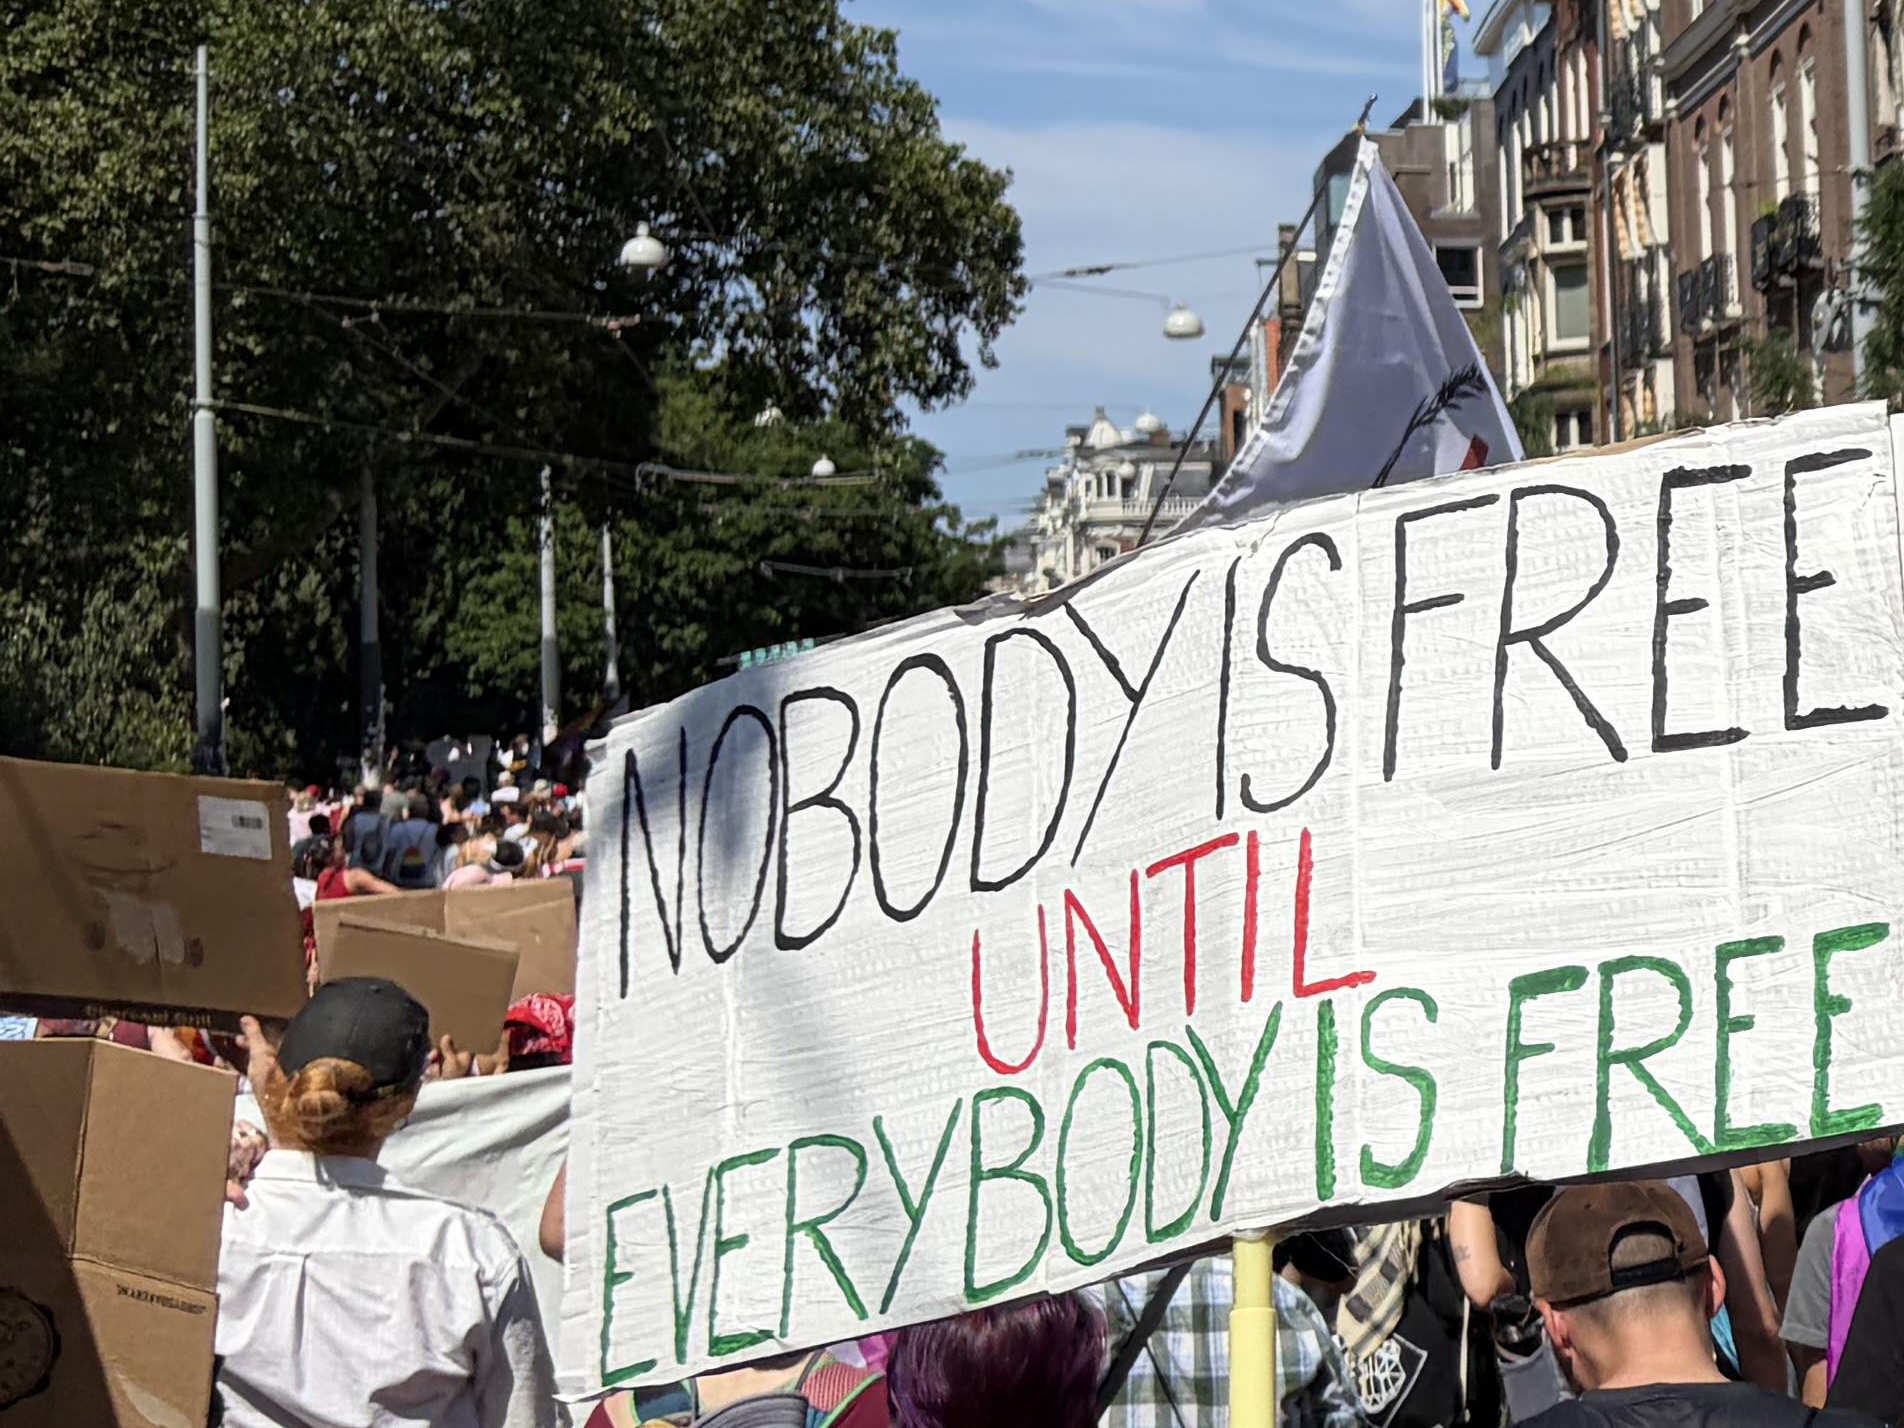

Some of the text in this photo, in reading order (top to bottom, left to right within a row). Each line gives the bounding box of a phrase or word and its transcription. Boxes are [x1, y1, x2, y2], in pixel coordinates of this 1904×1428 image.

[618, 446, 1891, 999] NOBODY IS FREE
[971, 826, 1377, 1076] UNTIL
[600, 921, 1893, 1389] EVERYBODY IS FREE
